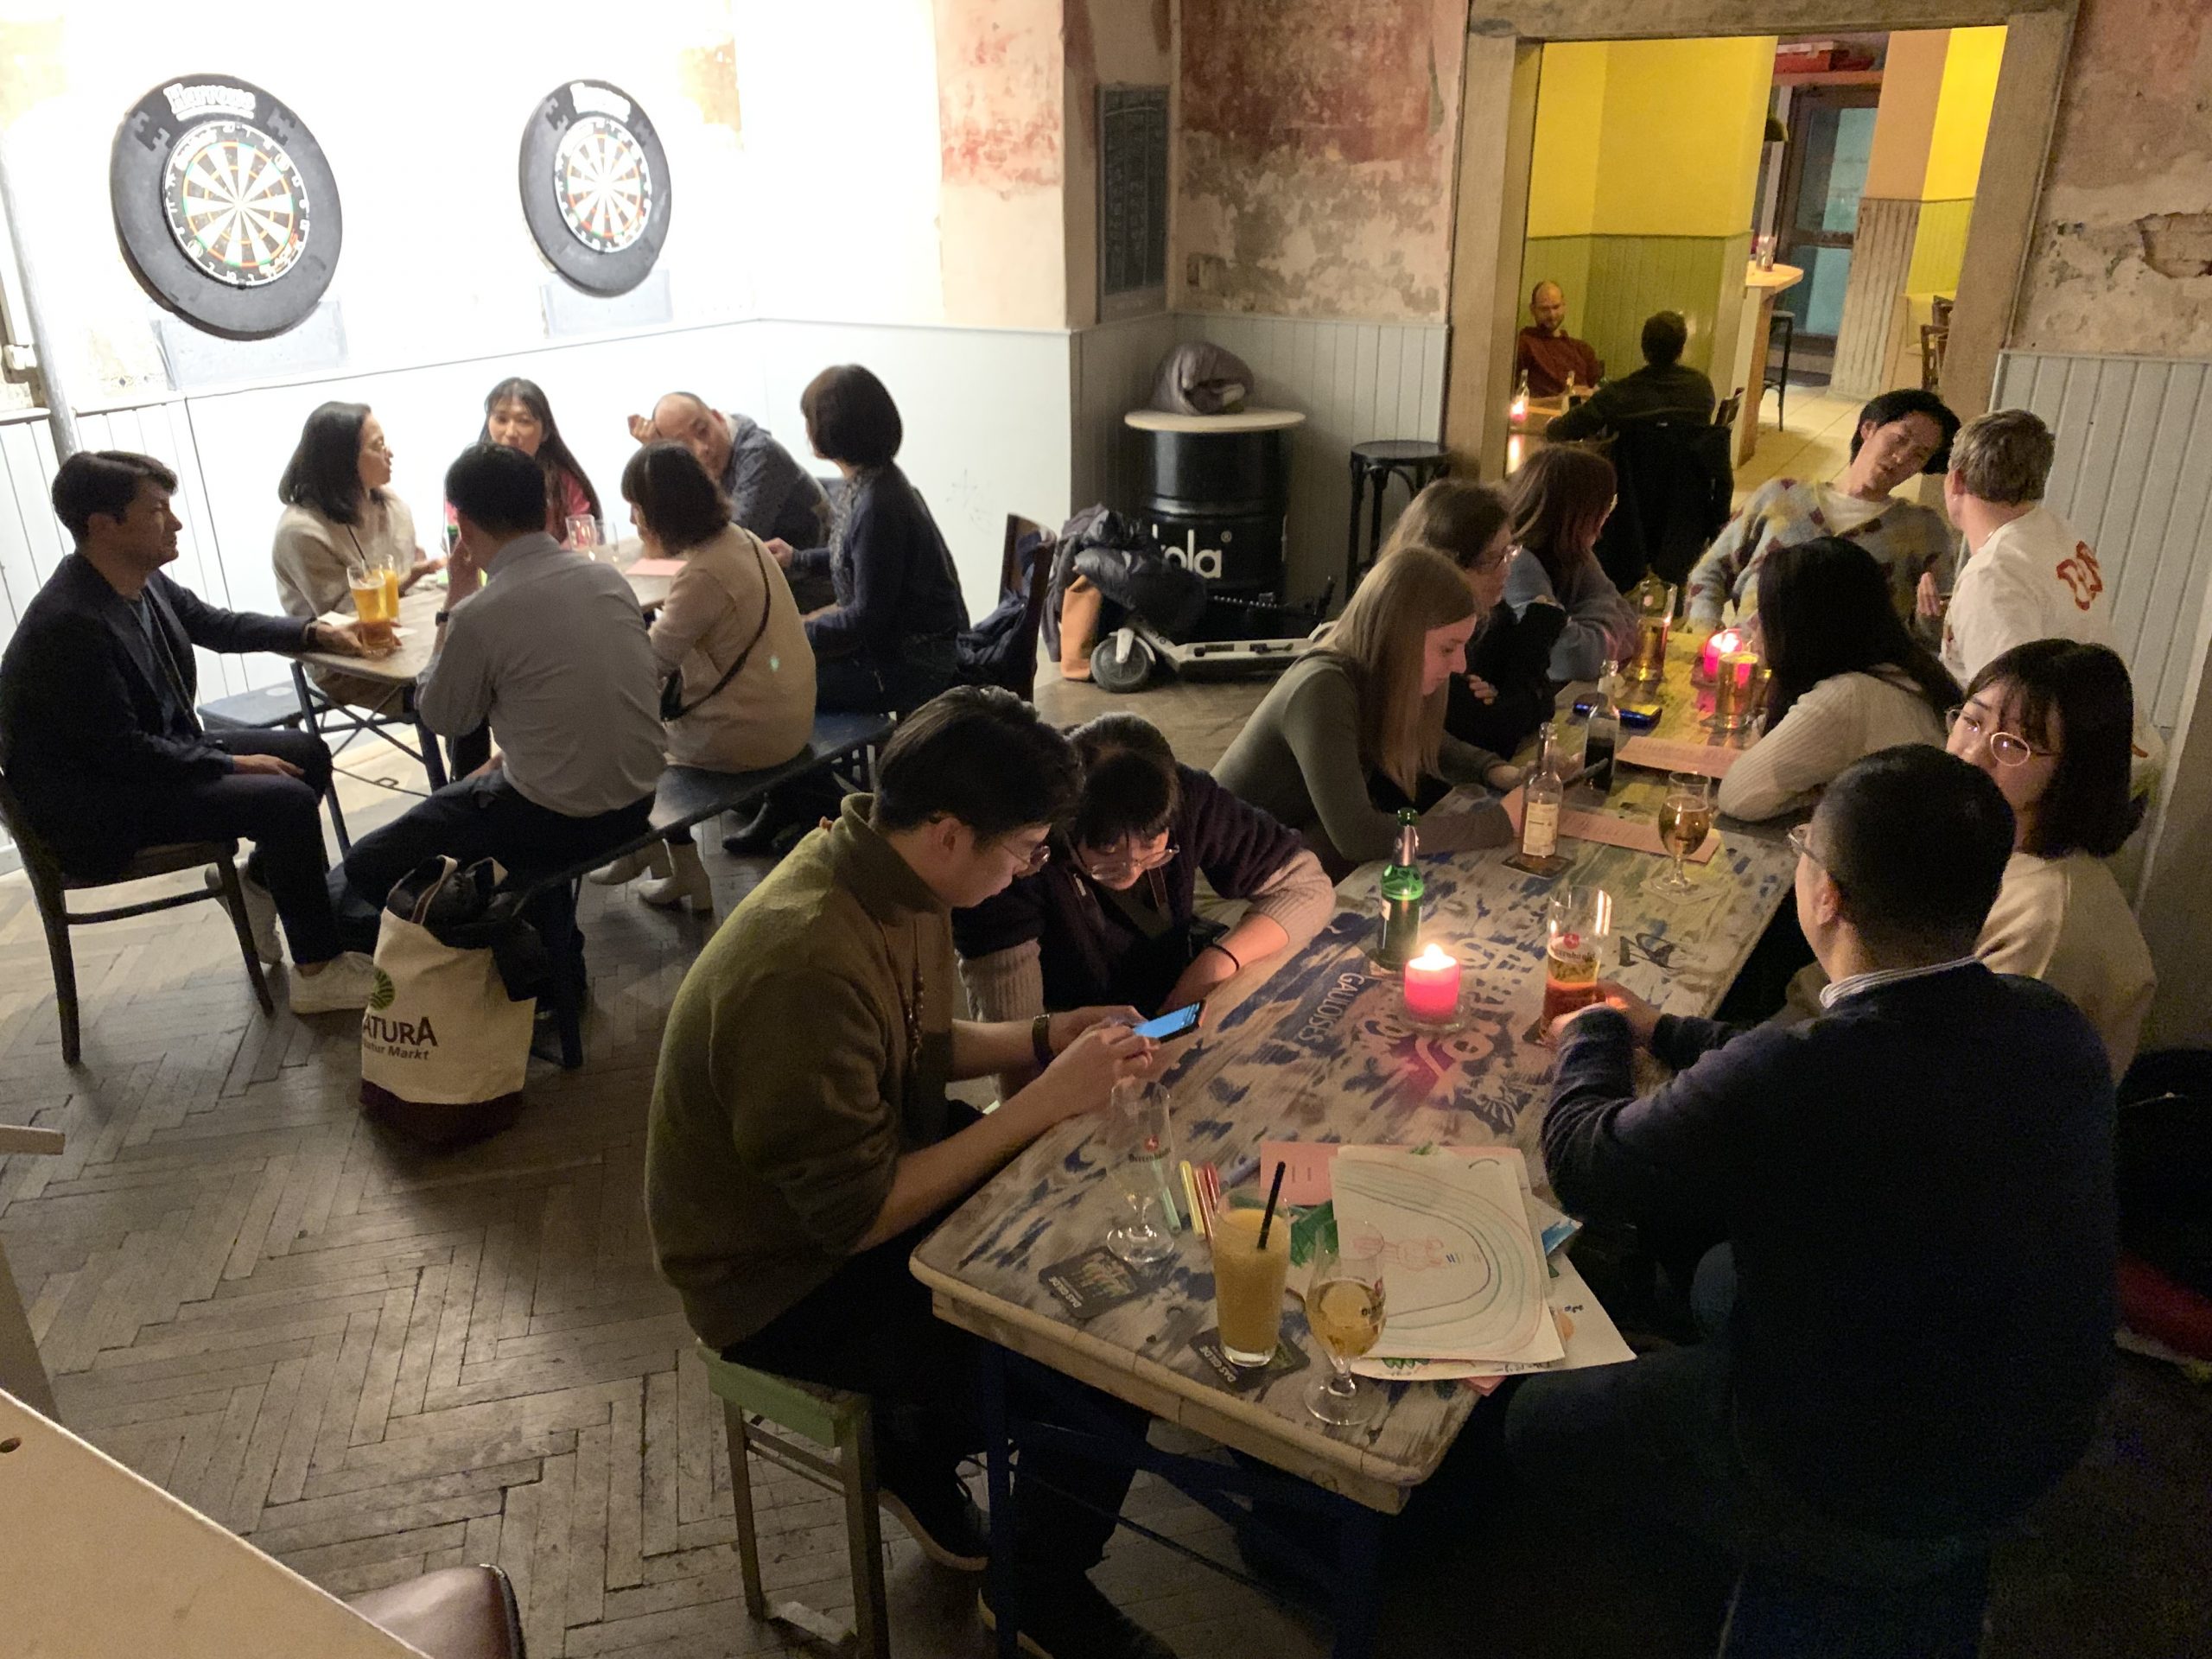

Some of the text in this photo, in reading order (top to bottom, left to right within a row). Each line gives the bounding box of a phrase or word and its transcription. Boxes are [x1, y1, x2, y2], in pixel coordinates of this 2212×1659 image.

[1299, 972, 1364, 1043] GAULOISES
[388, 1046, 429, 1060] Markt
[1218, 1366, 1236, 1382] DAS
